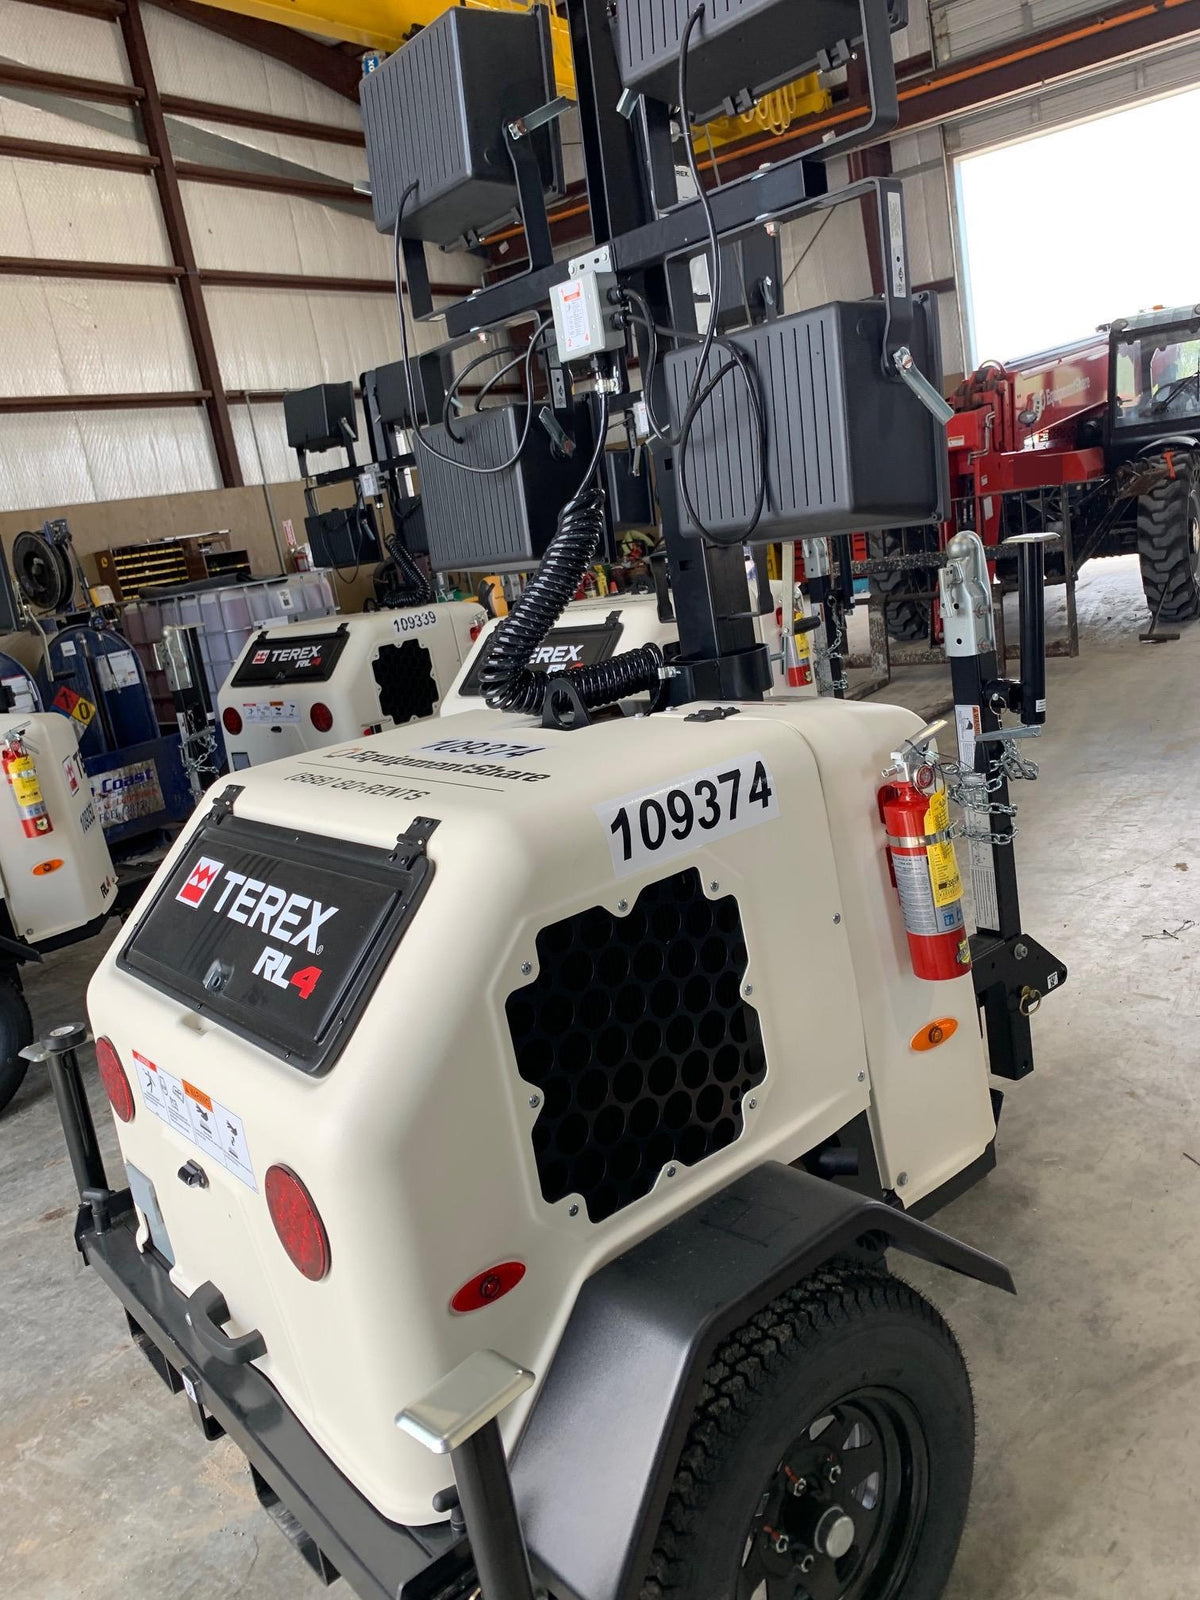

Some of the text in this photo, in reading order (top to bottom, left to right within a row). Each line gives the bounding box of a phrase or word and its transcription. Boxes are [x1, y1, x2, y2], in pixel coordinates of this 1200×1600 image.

[393, 611, 437, 633] 109339
[271, 645, 322, 662] TEREX
[79, 702, 90, 720] 0
[421, 739, 546, 758] 109374
[350, 750, 551, 783] EquipmentShare
[102, 768, 153, 793] Coast
[331, 780, 431, 801] 80-RENTS
[611, 761, 772, 861] 109374
[213, 871, 339, 953] TEREX
[252, 946, 322, 1000] RL4
